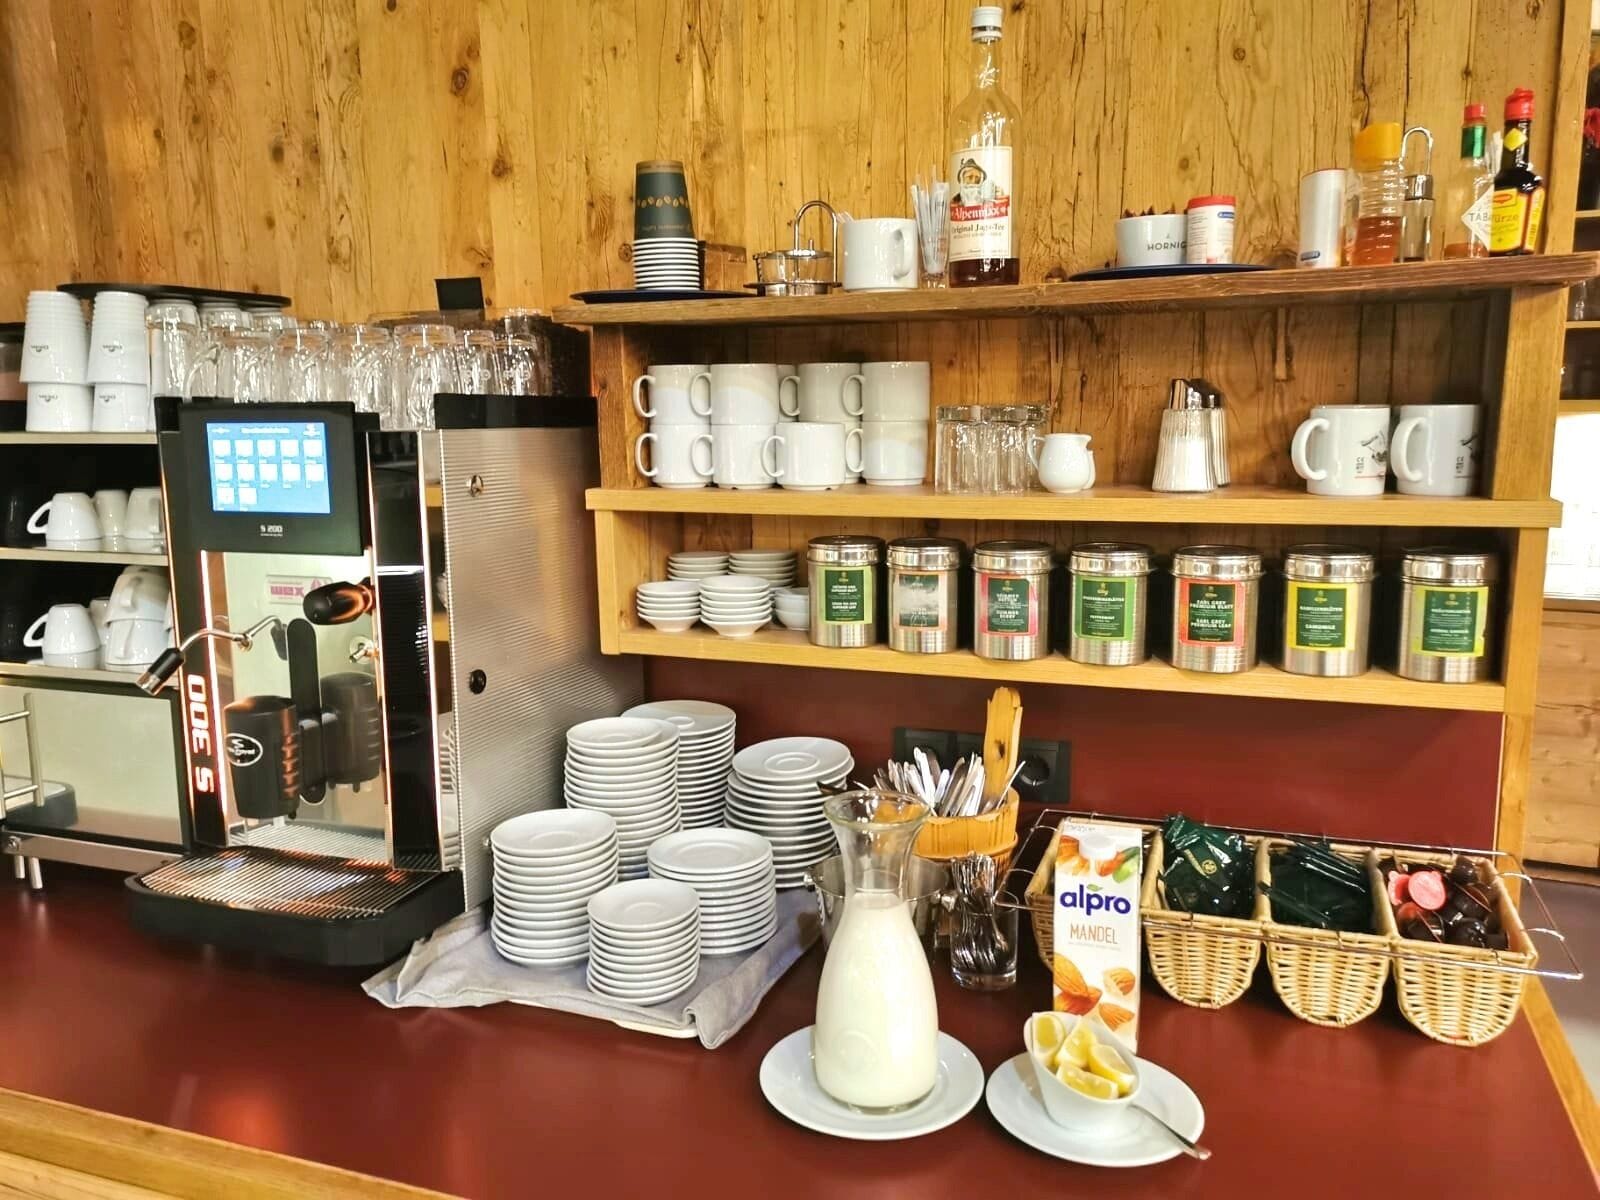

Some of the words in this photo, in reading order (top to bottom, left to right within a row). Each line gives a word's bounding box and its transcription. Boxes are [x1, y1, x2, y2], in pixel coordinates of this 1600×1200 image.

[187, 674, 212, 757] 300
[195, 766, 214, 793] S
[1060, 884, 1131, 916] alpro
[1070, 922, 1118, 945] MANDEL
